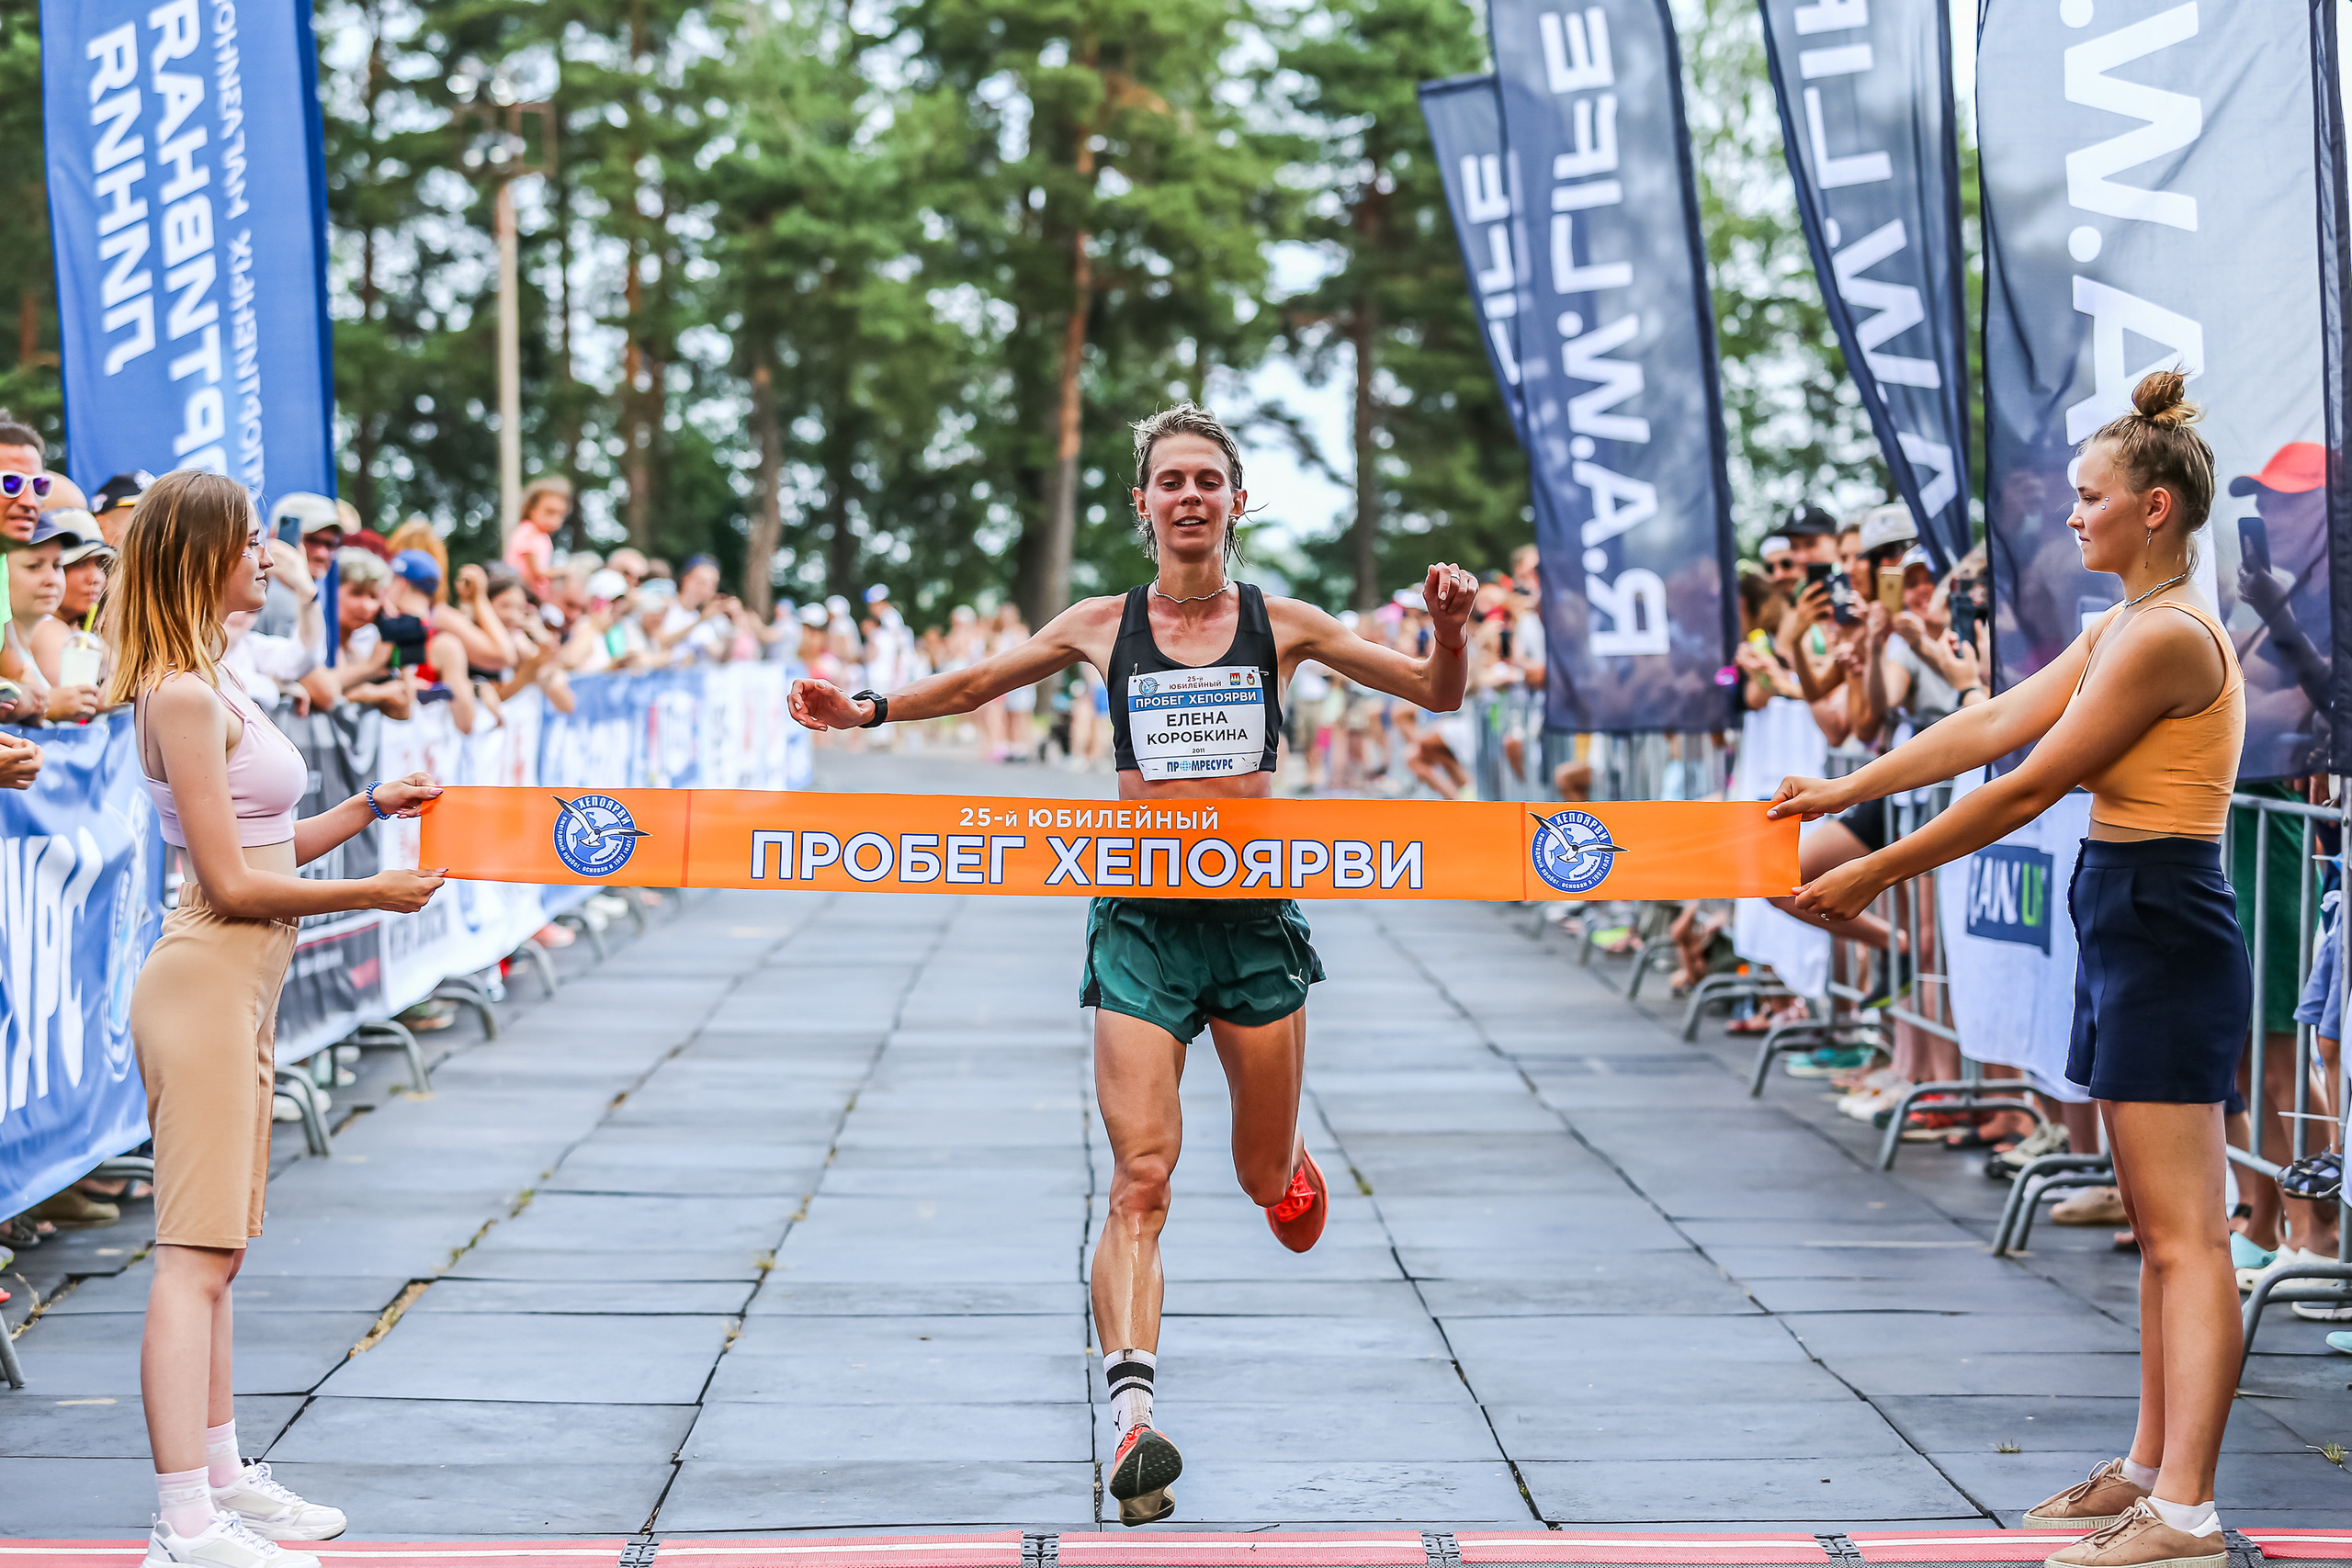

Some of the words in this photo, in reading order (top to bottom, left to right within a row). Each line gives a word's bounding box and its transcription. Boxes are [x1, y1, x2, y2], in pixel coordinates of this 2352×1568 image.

[1169, 680, 1222, 690] ЮБИЛЕЙНЫЙ
[1135, 695, 1185, 708] ПРОБЕГ
[1188, 691, 1257, 705] ХЕПОЯРВИ
[1166, 711, 1228, 728] ЕЛЕНА
[1147, 728, 1249, 746] КОРОБКИНА
[578, 796, 631, 826] ХЕПОЯРВИ
[959, 807, 1018, 827] 25-й
[1027, 804, 1220, 830] ЮБИЛЕЙНЫЙ
[1555, 812, 1609, 841] ХЕПОЯРВИ
[751, 829, 1026, 884] ПРОБЕГ
[1044, 836, 1424, 889] ХЕПОЯРВИ
[0, 825, 104, 1123] УРС
